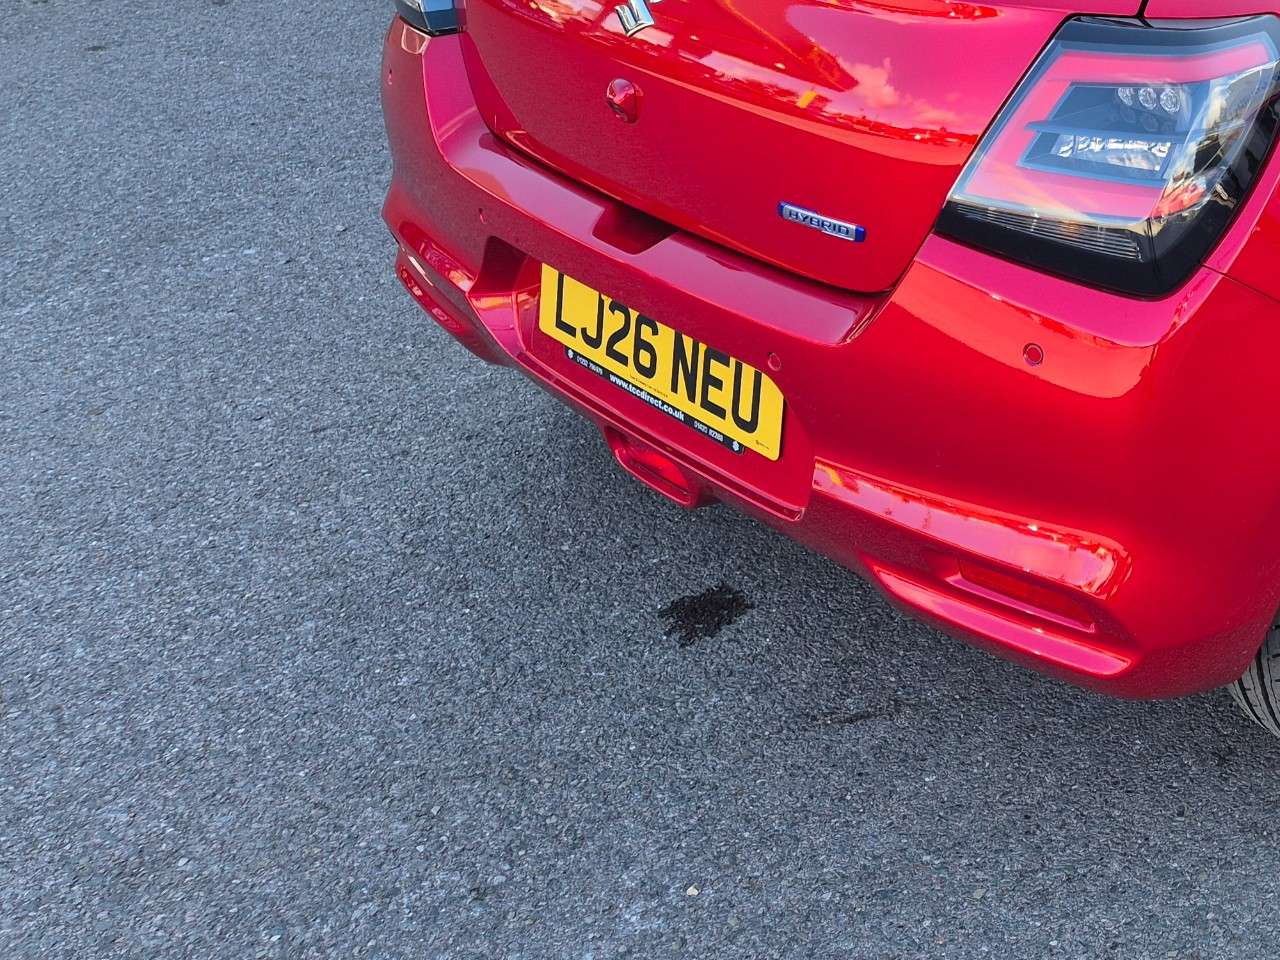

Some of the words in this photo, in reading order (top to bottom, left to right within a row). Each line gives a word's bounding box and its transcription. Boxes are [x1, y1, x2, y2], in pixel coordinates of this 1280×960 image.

[788, 209, 850, 236] HYBRID
[555, 270, 659, 380] LJ26
[670, 328, 763, 434] NEU
